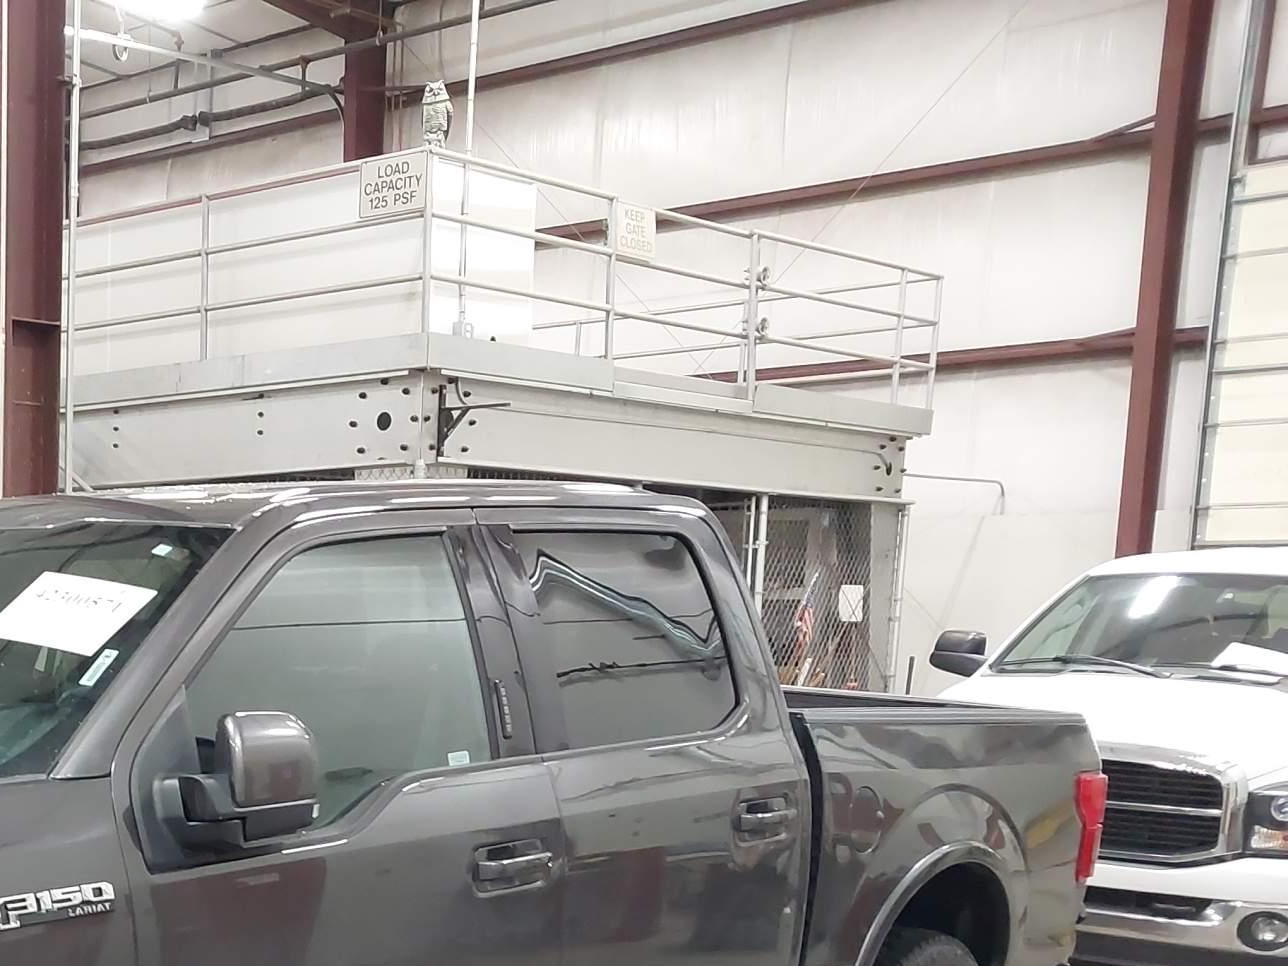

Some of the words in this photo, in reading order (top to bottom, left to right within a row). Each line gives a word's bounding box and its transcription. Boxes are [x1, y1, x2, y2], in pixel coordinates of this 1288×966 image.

[377, 161, 410, 179] LOAD
[364, 173, 423, 196] CAPACITY
[368, 195, 389, 211] 125
[393, 190, 418, 206] PSF
[624, 207, 646, 224] KEEP
[625, 222, 648, 239] GATE
[619, 235, 653, 253] CLOSED
[67, 902, 112, 918] LARIAT
